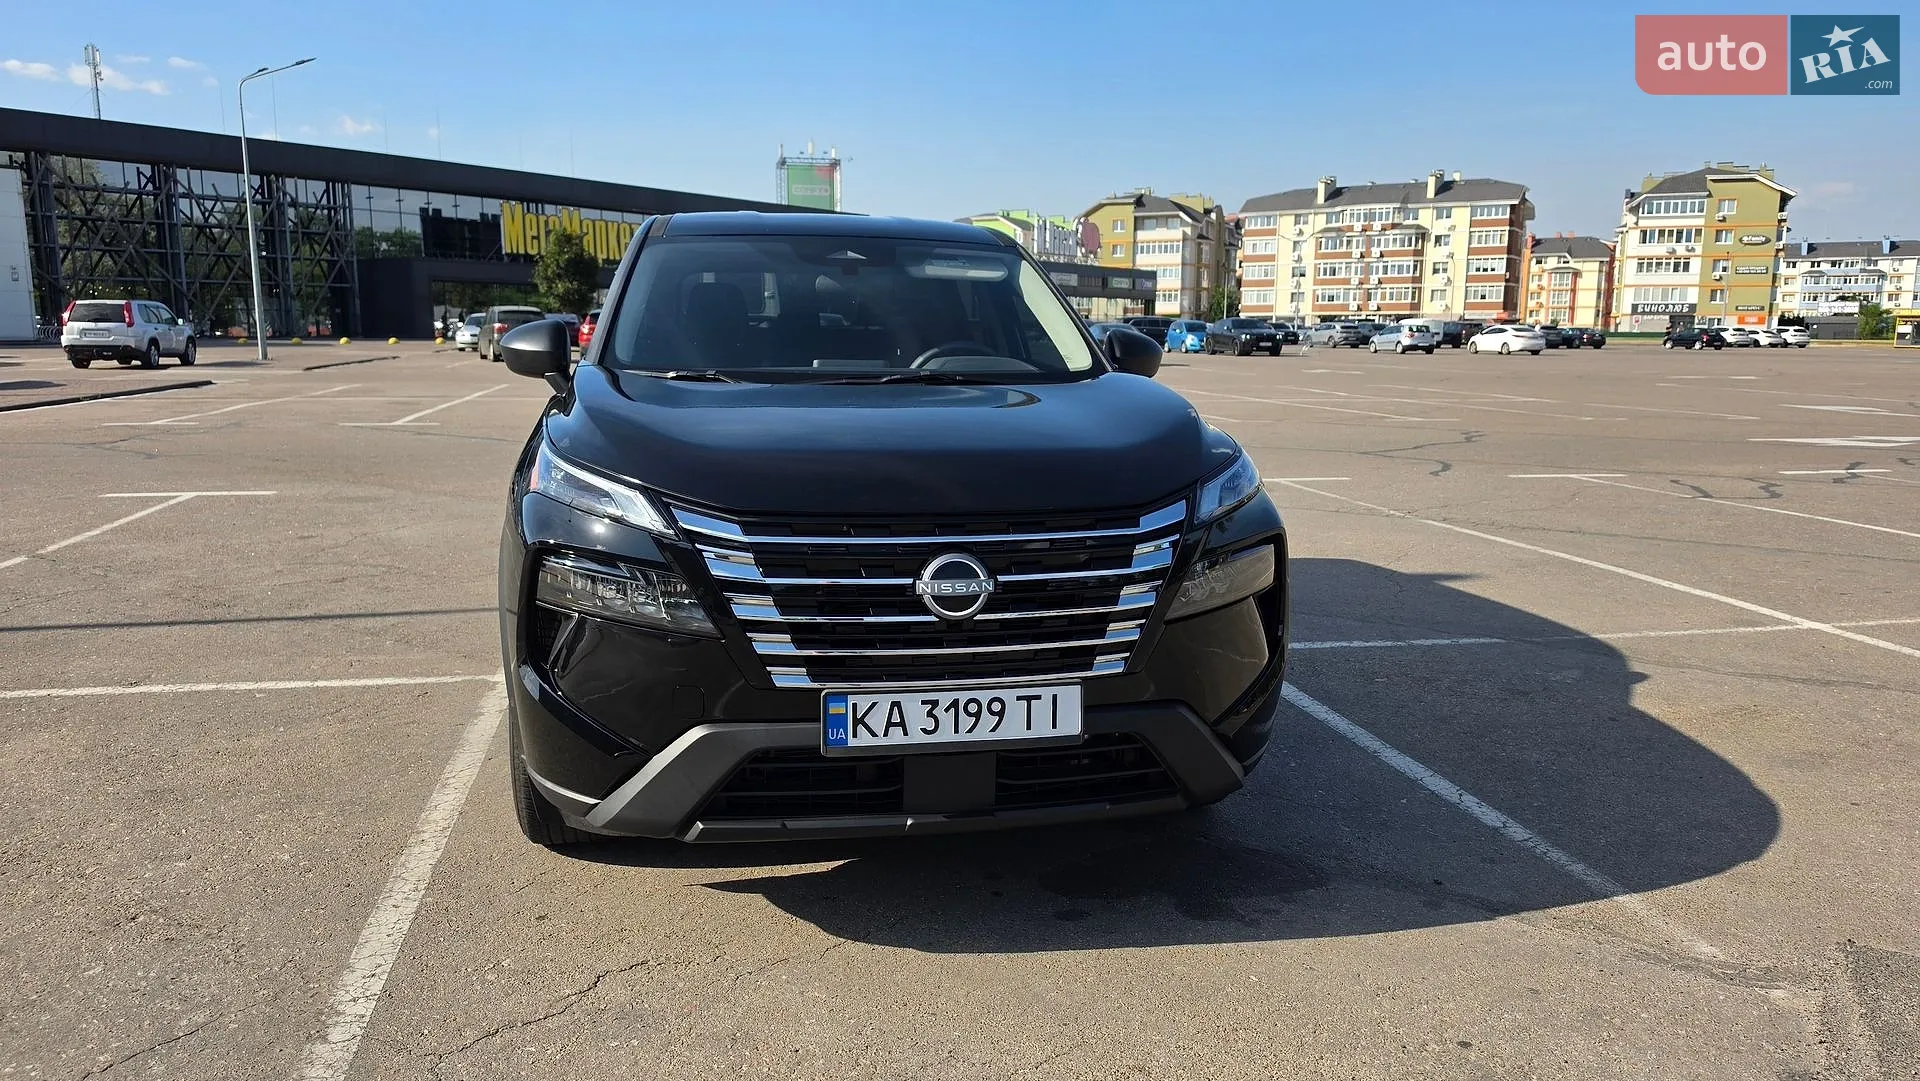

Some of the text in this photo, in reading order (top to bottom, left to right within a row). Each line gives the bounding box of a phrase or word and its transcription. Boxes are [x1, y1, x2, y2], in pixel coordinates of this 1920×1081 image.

[501, 201, 640, 267] МегМарке
[919, 581, 993, 593] NISSAN
[850, 700, 909, 739] KA
[919, 696, 1007, 736] 3199
[828, 728, 846, 740] UA
